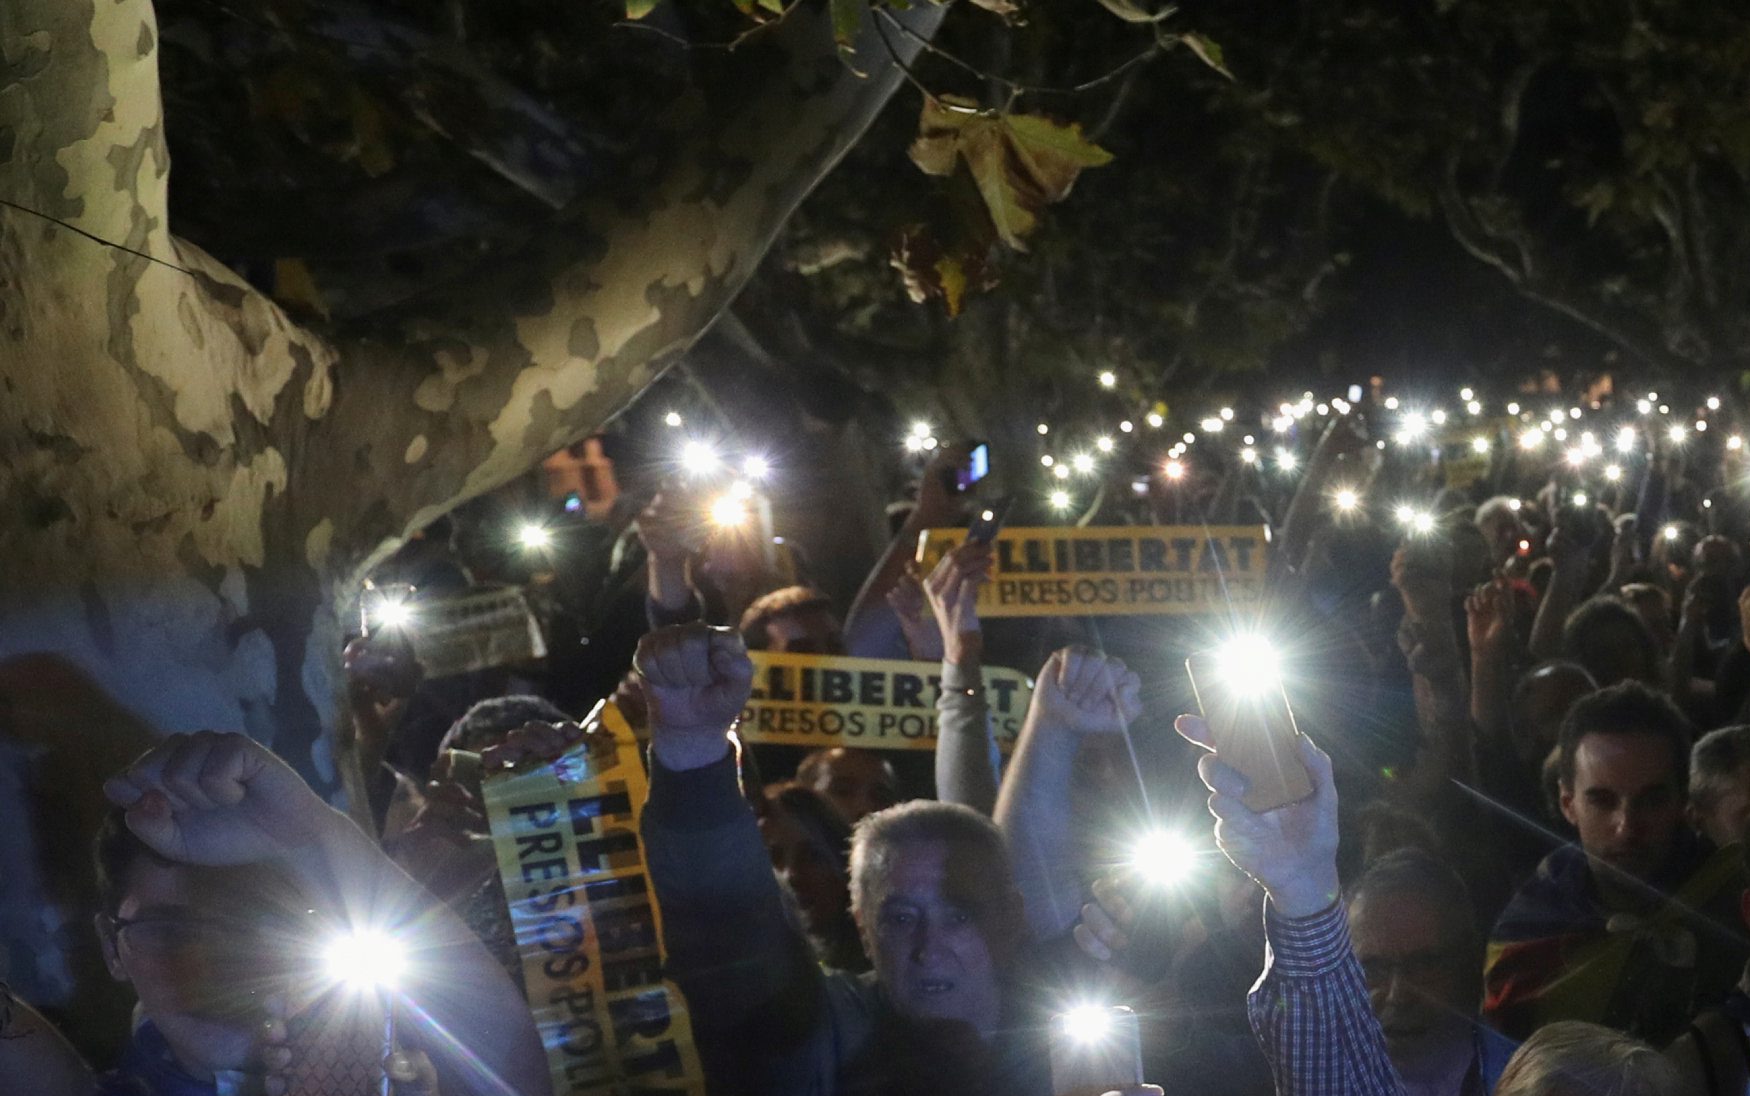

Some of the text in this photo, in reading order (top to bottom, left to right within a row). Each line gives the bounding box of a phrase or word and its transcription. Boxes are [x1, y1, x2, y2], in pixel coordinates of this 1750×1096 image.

[999, 537, 1256, 574] LLIBERTAT
[1001, 578, 1119, 605] PRESOS
[742, 704, 865, 737] PRESOS
[509, 802, 590, 982] PRESOS
